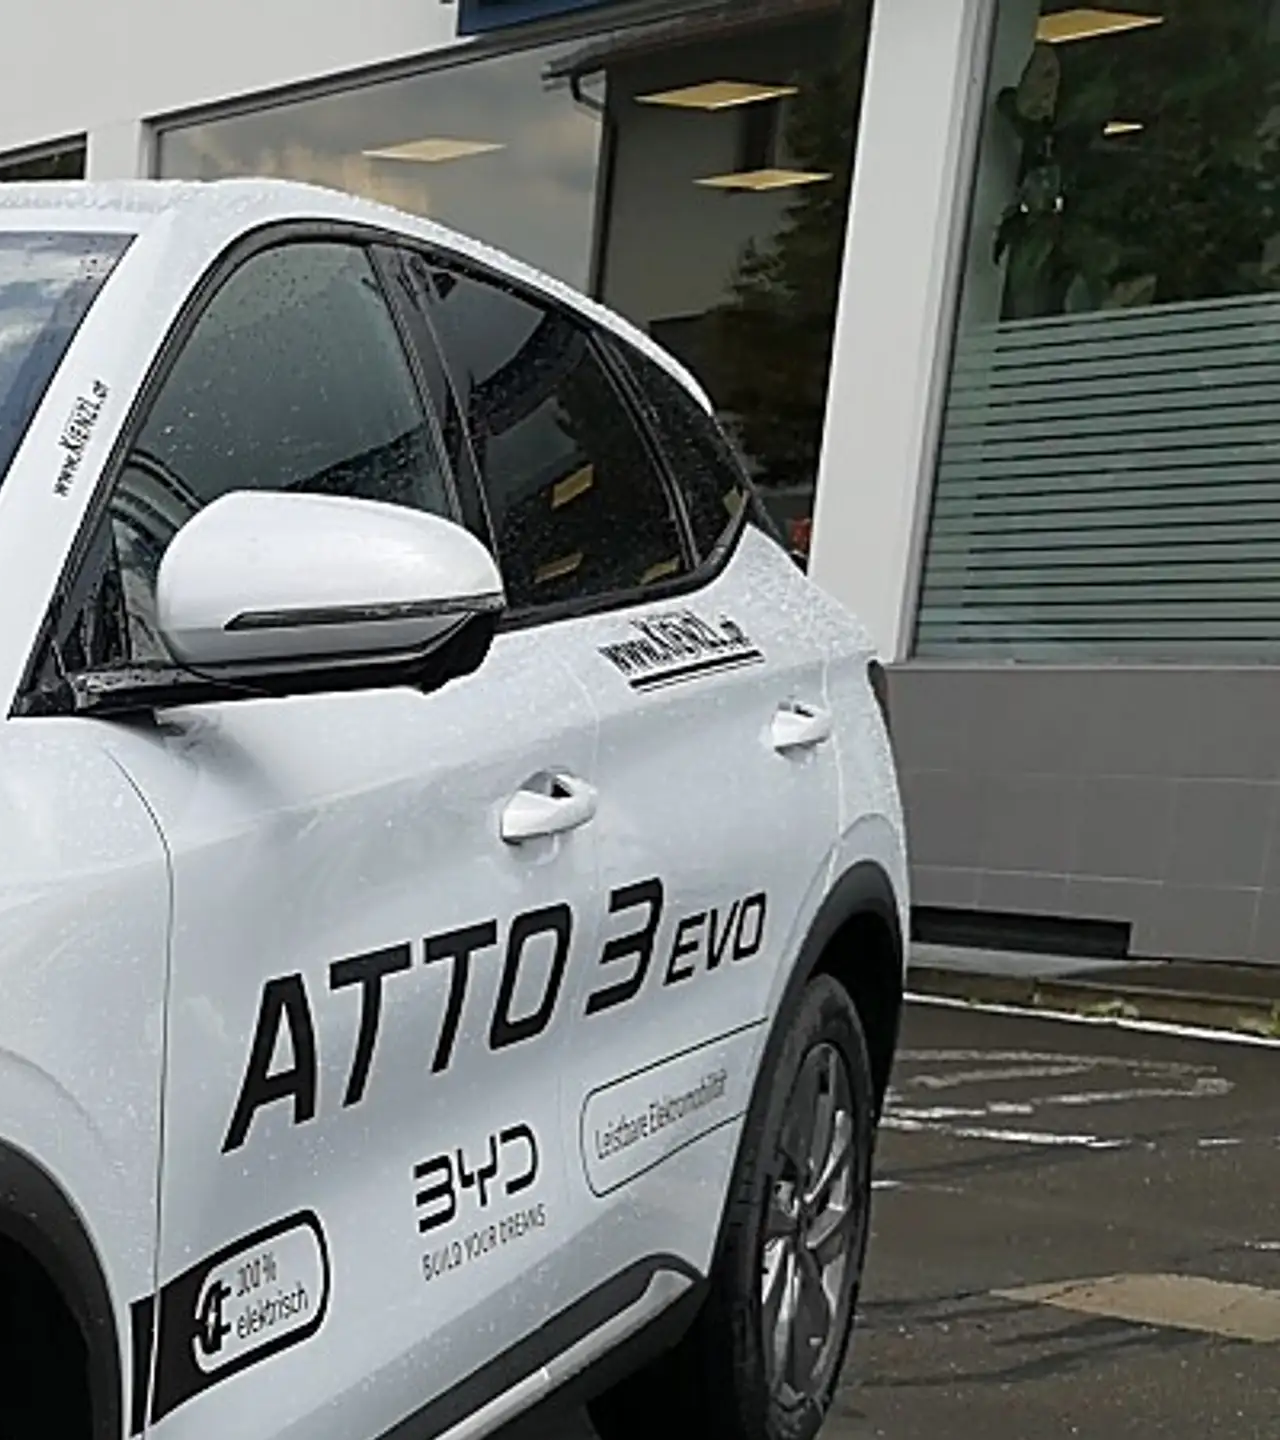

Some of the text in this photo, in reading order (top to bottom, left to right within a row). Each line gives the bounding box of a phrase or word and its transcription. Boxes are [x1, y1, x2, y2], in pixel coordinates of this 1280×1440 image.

[222, 876, 766, 1154] ATTO 3 EVO
[414, 1123, 538, 1232] BYD
[422, 1203, 546, 1281] BUILD YOUR DREAMS
[237, 1280, 308, 1339] elektrisch
